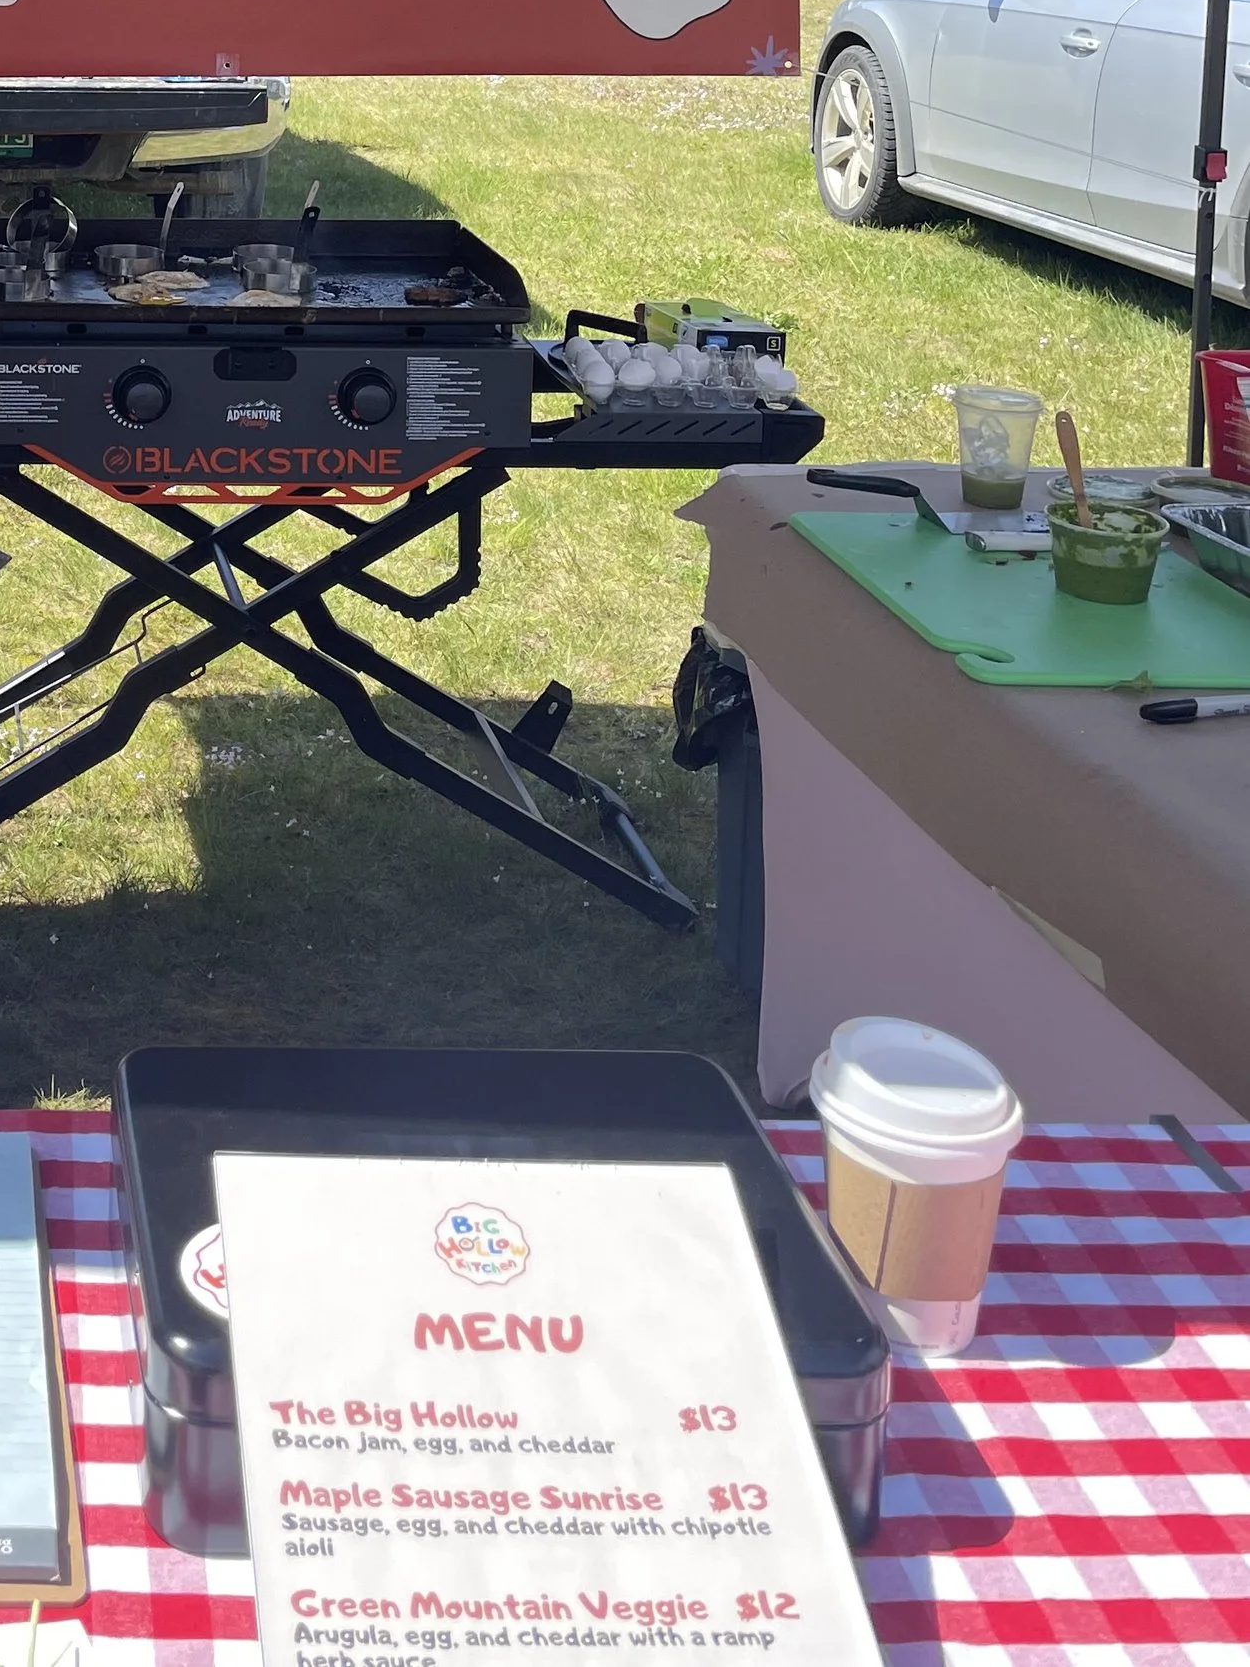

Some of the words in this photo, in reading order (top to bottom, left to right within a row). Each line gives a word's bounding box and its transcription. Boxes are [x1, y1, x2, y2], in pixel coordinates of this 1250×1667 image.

[226, 409, 282, 423] ADVENTURE
[136, 447, 403, 475] BLACKSTONE
[451, 1215, 500, 1234] BIG
[438, 1236, 527, 1258] HOLLOW
[413, 1311, 584, 1353] MENU
[268, 1399, 337, 1426] The
[344, 1400, 403, 1433] Big
[409, 1401, 518, 1429] Hollow
[678, 1404, 738, 1433] $13
[272, 1428, 350, 1450] Bacon
[357, 1431, 408, 1454] jam,
[413, 1434, 464, 1455] egg,
[469, 1434, 512, 1453] and
[518, 1435, 615, 1454] cheddar
[279, 1479, 383, 1514] Maple
[391, 1483, 532, 1516] Sausage
[539, 1485, 664, 1511] Sunrise
[708, 1482, 769, 1513] $13
[281, 1512, 390, 1536] Sausage,
[396, 1517, 448, 1537] egg,
[454, 1516, 498, 1535] and
[504, 1515, 605, 1536] cheddar
[610, 1516, 666, 1536] with
[671, 1517, 772, 1540] chipotle
[284, 1537, 335, 1557] aioli
[290, 1588, 401, 1619] Green
[410, 1590, 573, 1620] Mountain
[577, 1590, 709, 1626] Veggie
[735, 1589, 800, 1622] $12
[293, 1621, 399, 1649] Arugula,
[404, 1627, 460, 1650] egg,
[465, 1626, 512, 1647] and
[517, 1626, 622, 1647] cheddar
[628, 1626, 685, 1647] with
[690, 1631, 706, 1647] a
[710, 1631, 775, 1651] ramp
[296, 1650, 355, 1667] herb
[362, 1654, 437, 1667] sauce
